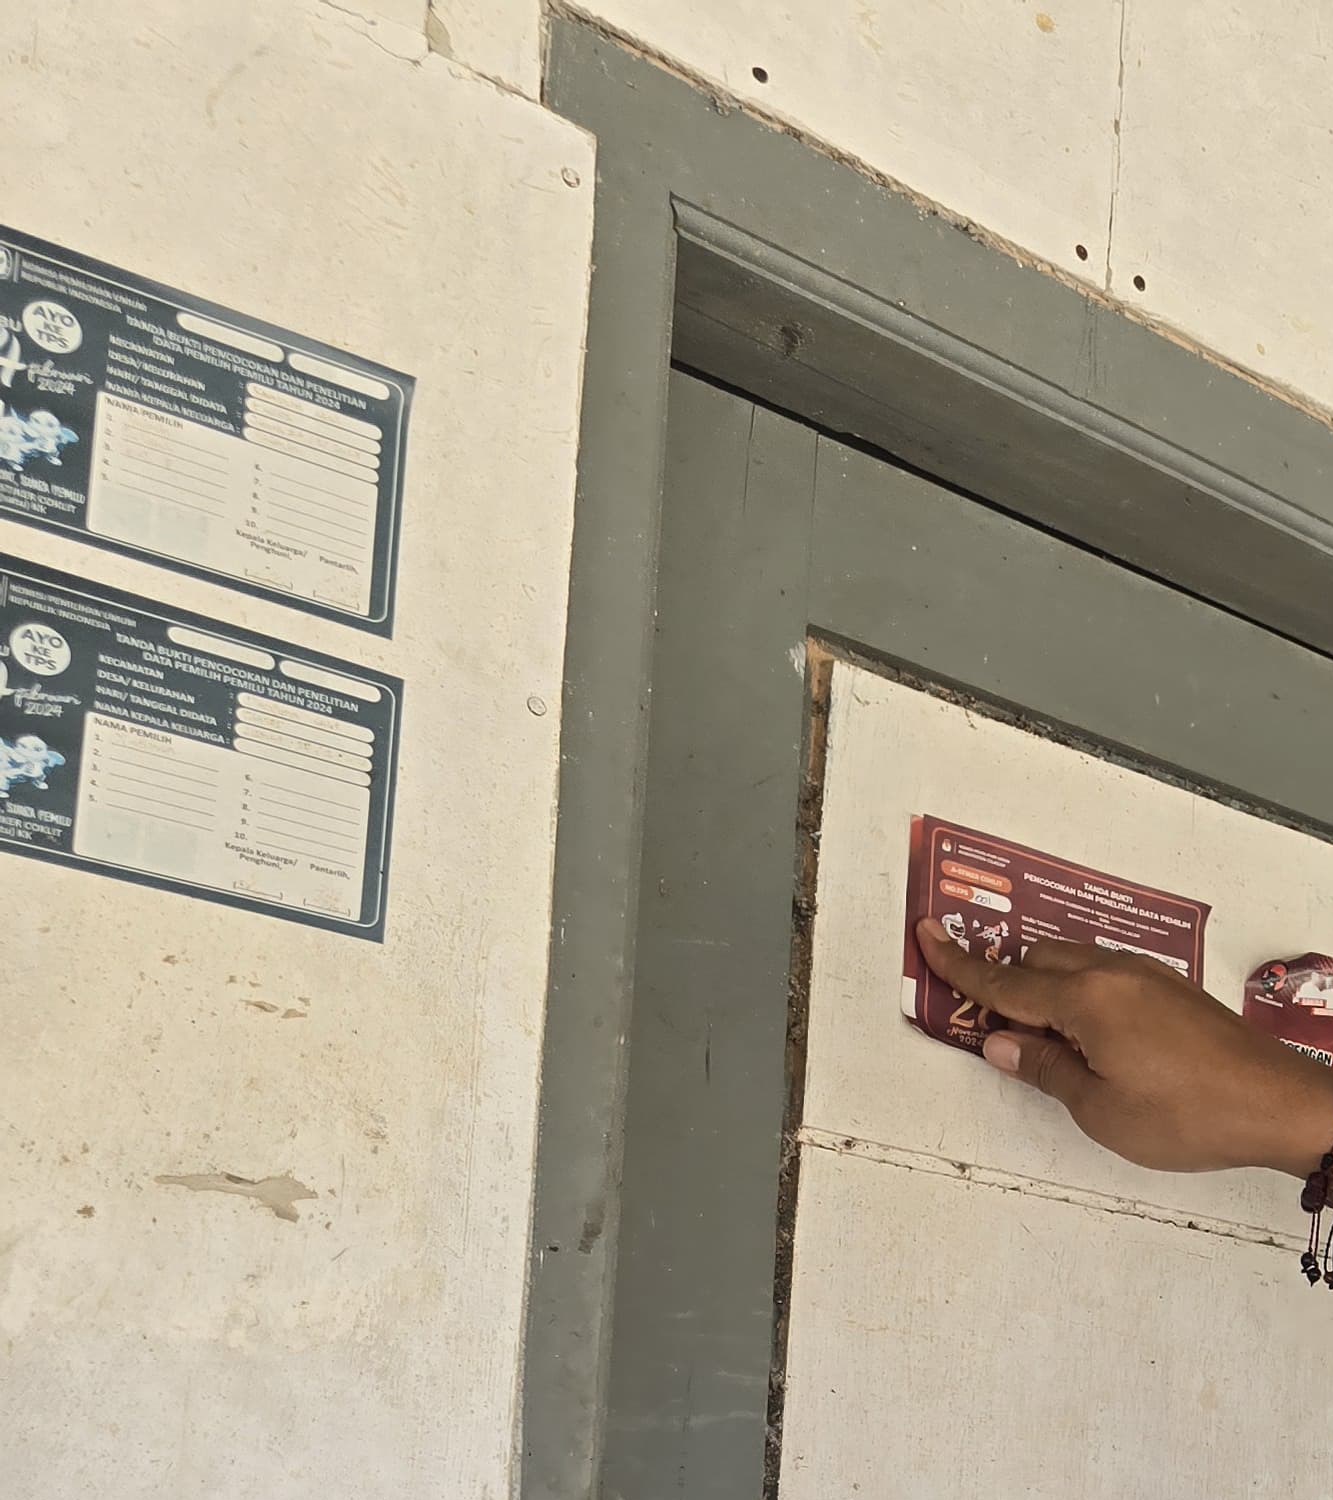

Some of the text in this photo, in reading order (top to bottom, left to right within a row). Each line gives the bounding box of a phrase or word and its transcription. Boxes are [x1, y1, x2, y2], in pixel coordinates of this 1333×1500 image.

[32, 305, 75, 327] AYO
[43, 320, 63, 333] KE
[36, 328, 69, 349] TPS
[109, 334, 175, 365] KECAMATAN
[126, 314, 367, 410] TANDA BUKTI PENCOCOKAN DAN PENELITIAN
[152, 335, 341, 410] DATA PEMILIH PEMILU TAHUN 2024
[105, 380, 140, 399] NAMA
[104, 397, 184, 429] NAMA PEMILIH
[190, 393, 228, 414] DIDATA
[22, 628, 63, 648] AYO
[32, 644, 52, 657] KE
[24, 651, 57, 671] TPS
[98, 653, 164, 680] KECAMATAN
[116, 632, 359, 713] TANDA BUKTI PENCOCOKAN DAN PENELITIAN
[97, 669, 195, 704] DESA/ KELURAHAN
[142, 650, 333, 714] DATA PEMILIH PEMILU TAHUN 2024
[24, 700, 64, 718] 2024
[94, 700, 225, 744] NAMA KEPALA KELUARGA
[129, 694, 178, 715] TANGGAL
[179, 708, 217, 726] DIDATA
[94, 717, 173, 745] NAMA PEMILIH
[25, 821, 63, 837] COKLIT
[224, 841, 298, 867] Kepala Keluarga/
[239, 853, 283, 871] Penghuni,
[1023, 872, 1077, 896] PENCOCOKAN
[1077, 889, 1094, 901] DAN
[1094, 894, 1138, 915] PENELITIAN
[1139, 908, 1159, 921] DATA
[1160, 914, 1192, 930] PEMILIH
[1083, 882, 1134, 904] TANDA BUKTI
